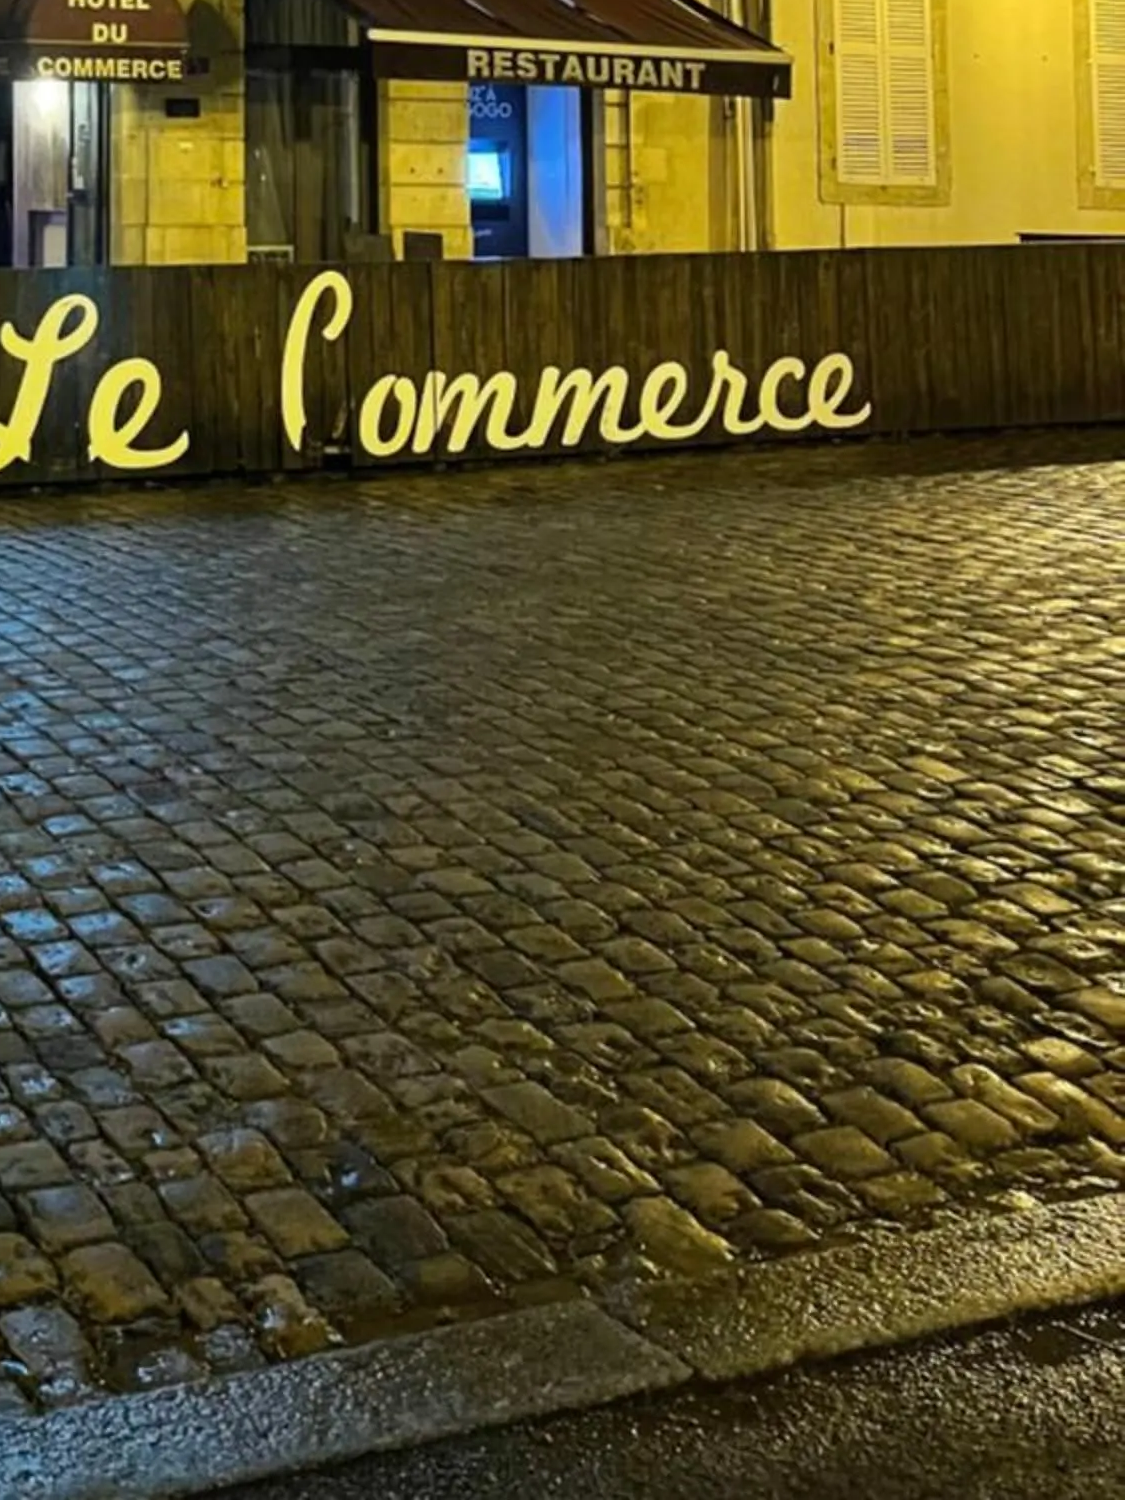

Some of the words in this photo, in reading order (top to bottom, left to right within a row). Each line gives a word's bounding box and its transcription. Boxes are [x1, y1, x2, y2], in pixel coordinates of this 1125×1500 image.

[91, 22, 128, 43] DU
[36, 56, 183, 79] COMMERCE
[466, 48, 707, 92] RESTAURANT
[280, 270, 873, 459] Commerce
